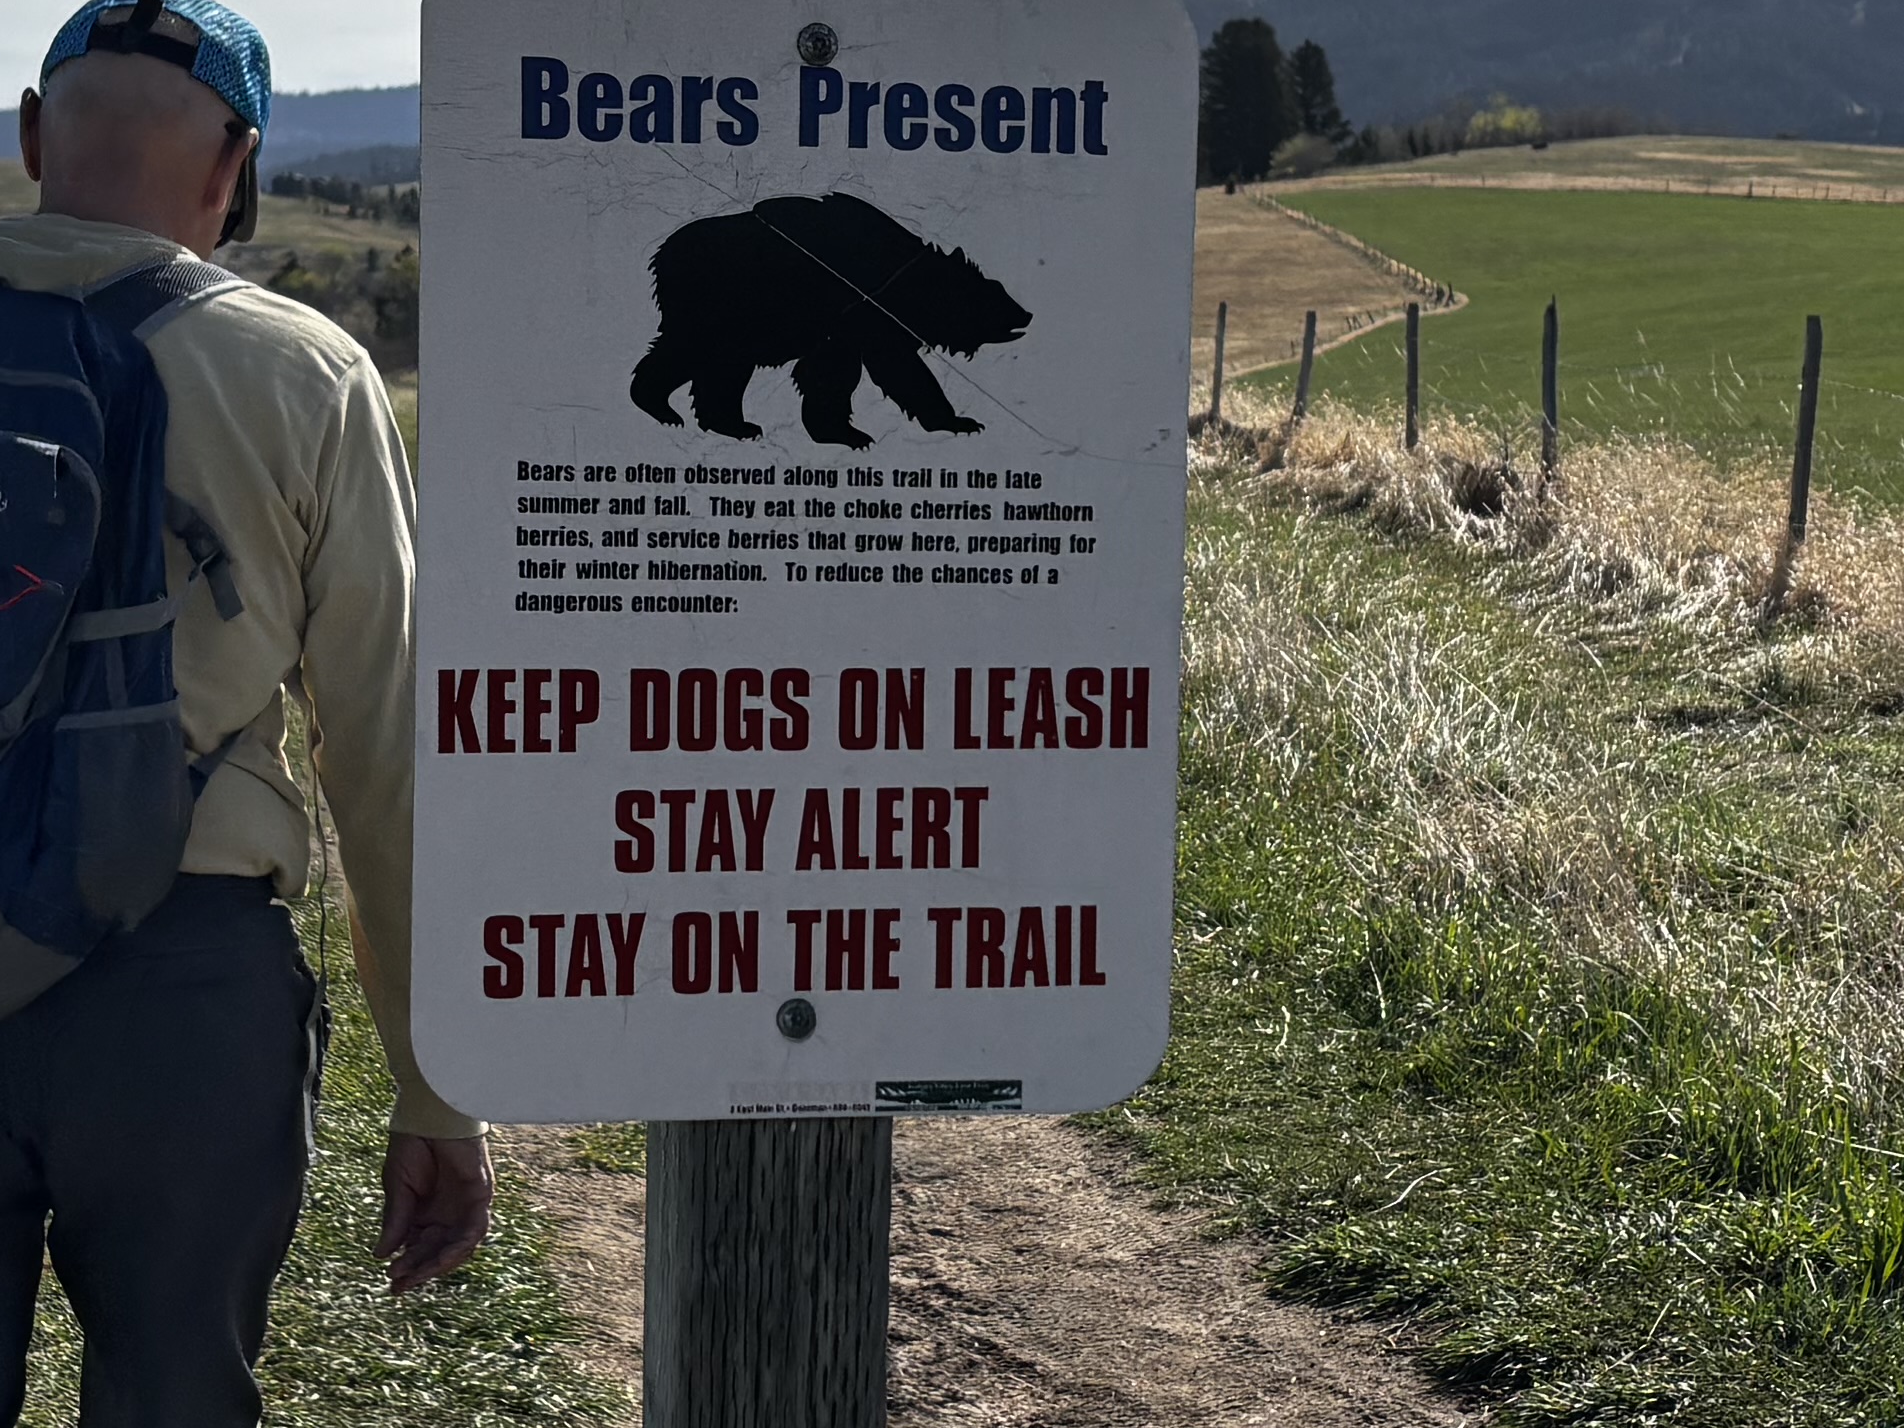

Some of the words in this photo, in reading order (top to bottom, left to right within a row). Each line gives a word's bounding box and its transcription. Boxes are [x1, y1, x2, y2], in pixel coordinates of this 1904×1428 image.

[521, 56, 759, 146] Bears
[798, 65, 1108, 155] Present
[516, 459, 576, 483] Bears
[584, 466, 616, 482] are
[625, 463, 676, 484] often
[683, 464, 776, 485] observed
[784, 466, 838, 488] along
[847, 466, 883, 487] this
[892, 468, 932, 488] trail
[940, 468, 958, 488] in
[967, 469, 997, 489] the
[1005, 470, 1042, 489] late
[517, 497, 600, 514] summer
[608, 495, 645, 515] and
[653, 495, 691, 517] fall.
[709, 496, 756, 519] They
[764, 499, 798, 517] eat
[804, 497, 835, 518] the
[844, 499, 902, 520] choke
[911, 500, 991, 520] cherries
[1004, 501, 1093, 521] hawthorn
[517, 526, 593, 549] berries,
[602, 528, 639, 547] and
[647, 528, 720, 549] service
[728, 529, 799, 550] berries
[807, 530, 846, 550] that
[855, 534, 903, 553] grow
[911, 532, 960, 553] here,
[968, 533, 1061, 555] preparing
[1070, 534, 1096, 553] for
[518, 558, 566, 579] their
[576, 559, 640, 580] winter
[648, 559, 767, 581] hibernation.
[785, 562, 807, 581] To
[816, 562, 883, 582] reduce
[892, 564, 923, 583] the
[932, 564, 1013, 584] chances
[1021, 565, 1039, 584] of
[1048, 569, 1058, 584] a
[515, 591, 623, 614] dangerous
[631, 594, 738, 613] encounter:
[438, 669, 599, 754] KEEP
[630, 668, 810, 752] DOGS
[839, 668, 925, 750] ON
[954, 667, 1150, 750] LEASH
[615, 788, 775, 873] STAY
[795, 786, 989, 871] ALERT
[483, 912, 646, 999] STAY
[672, 911, 759, 994] ON
[787, 908, 900, 992] THE
[927, 905, 1106, 989] TRAIL
